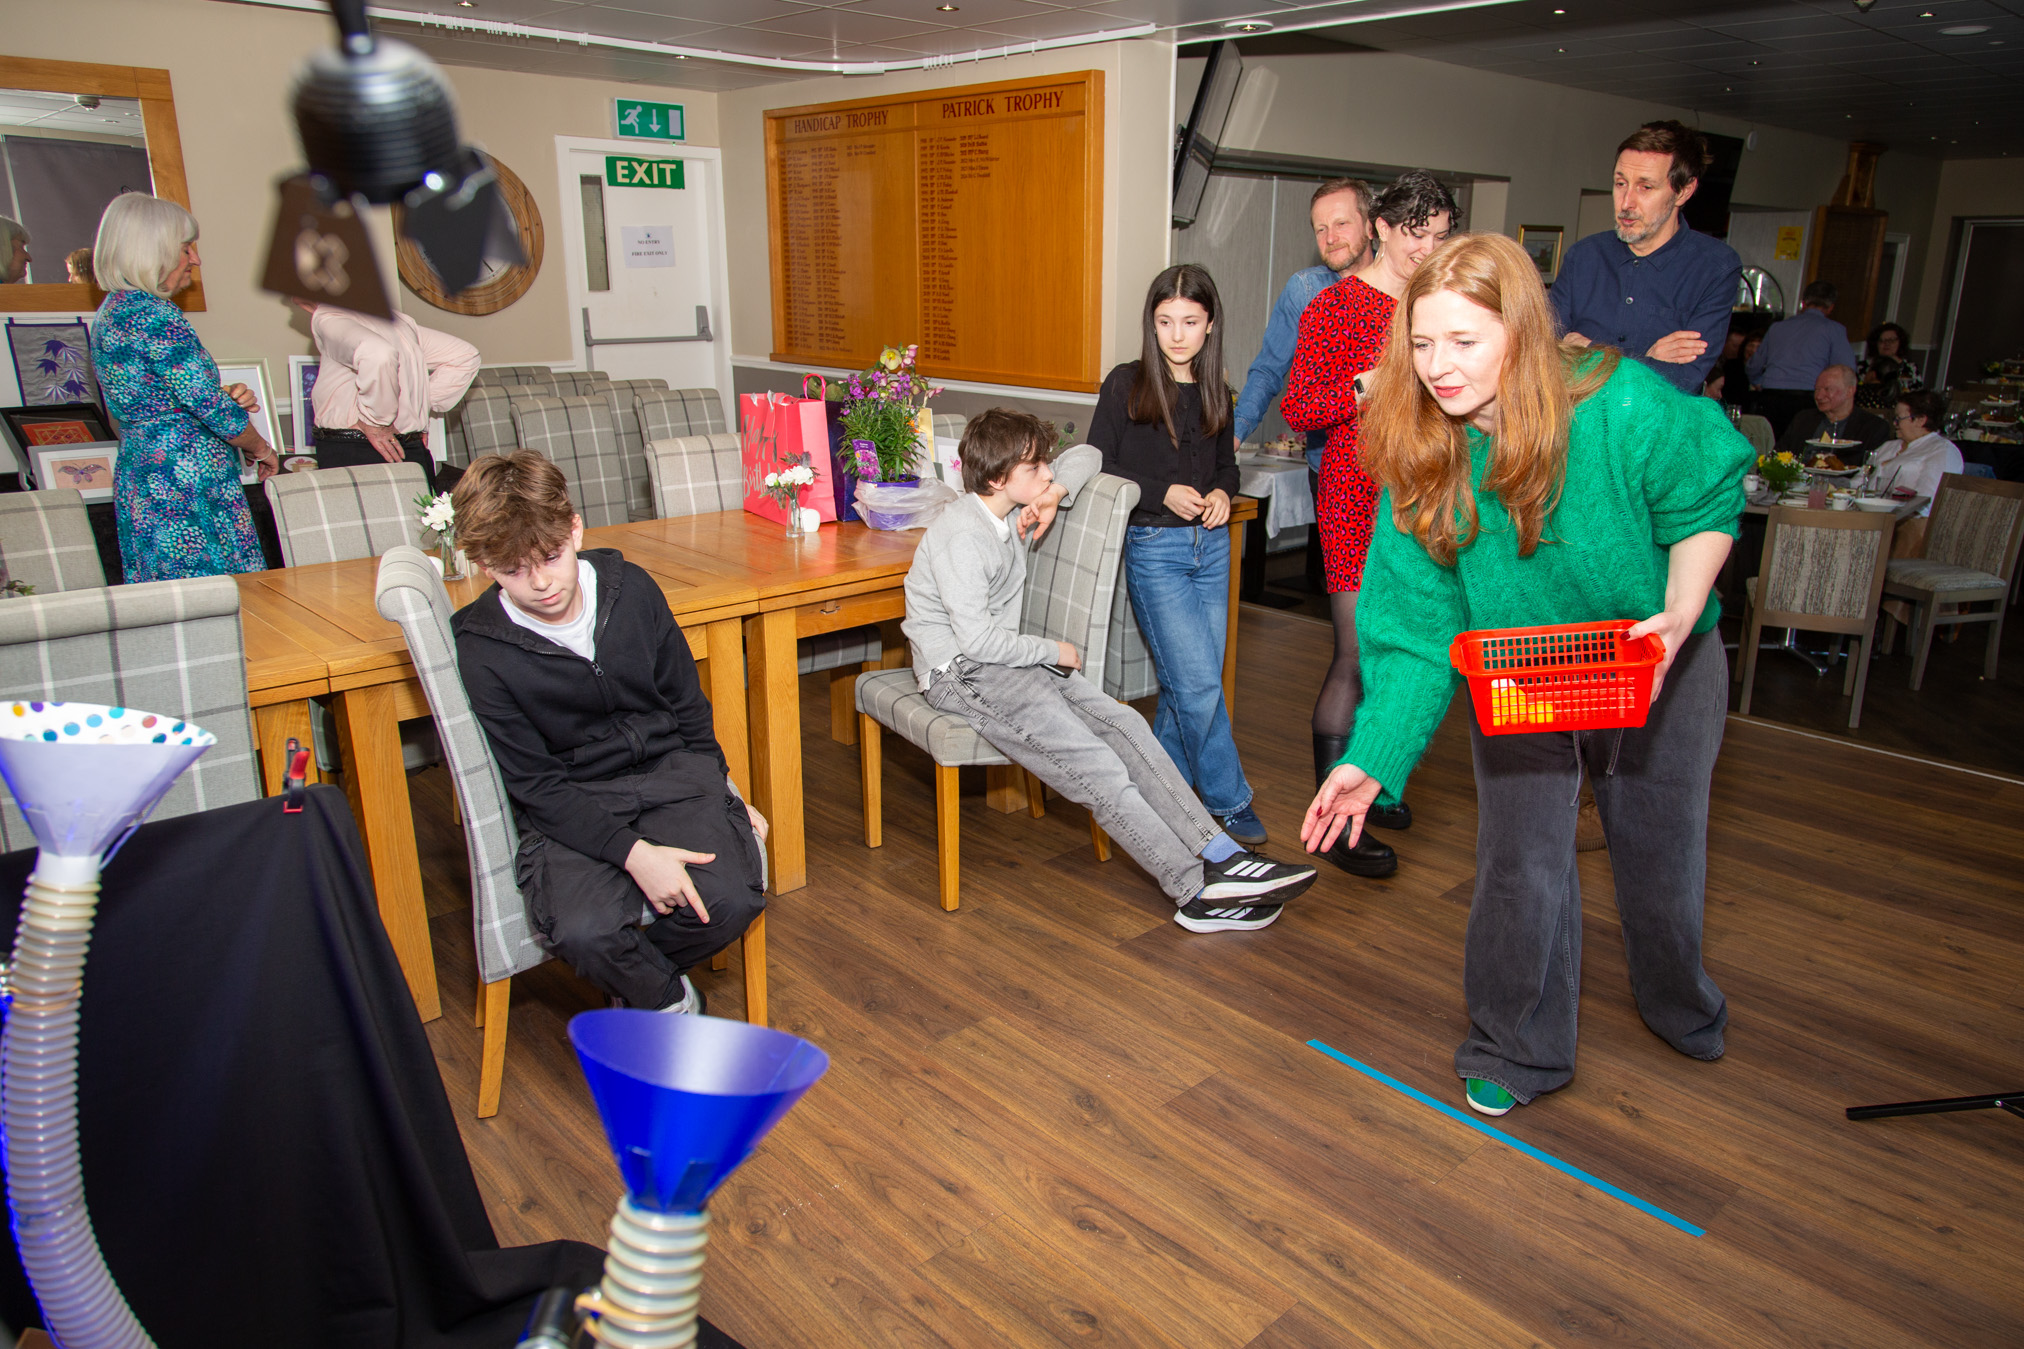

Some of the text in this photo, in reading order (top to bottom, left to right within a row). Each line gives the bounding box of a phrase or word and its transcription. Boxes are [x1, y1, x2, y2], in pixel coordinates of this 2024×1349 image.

[942, 90, 1064, 119] PATRICK TROPHY
[794, 110, 889, 134] HANDICAP TROPHY
[616, 161, 677, 185] EXIT
